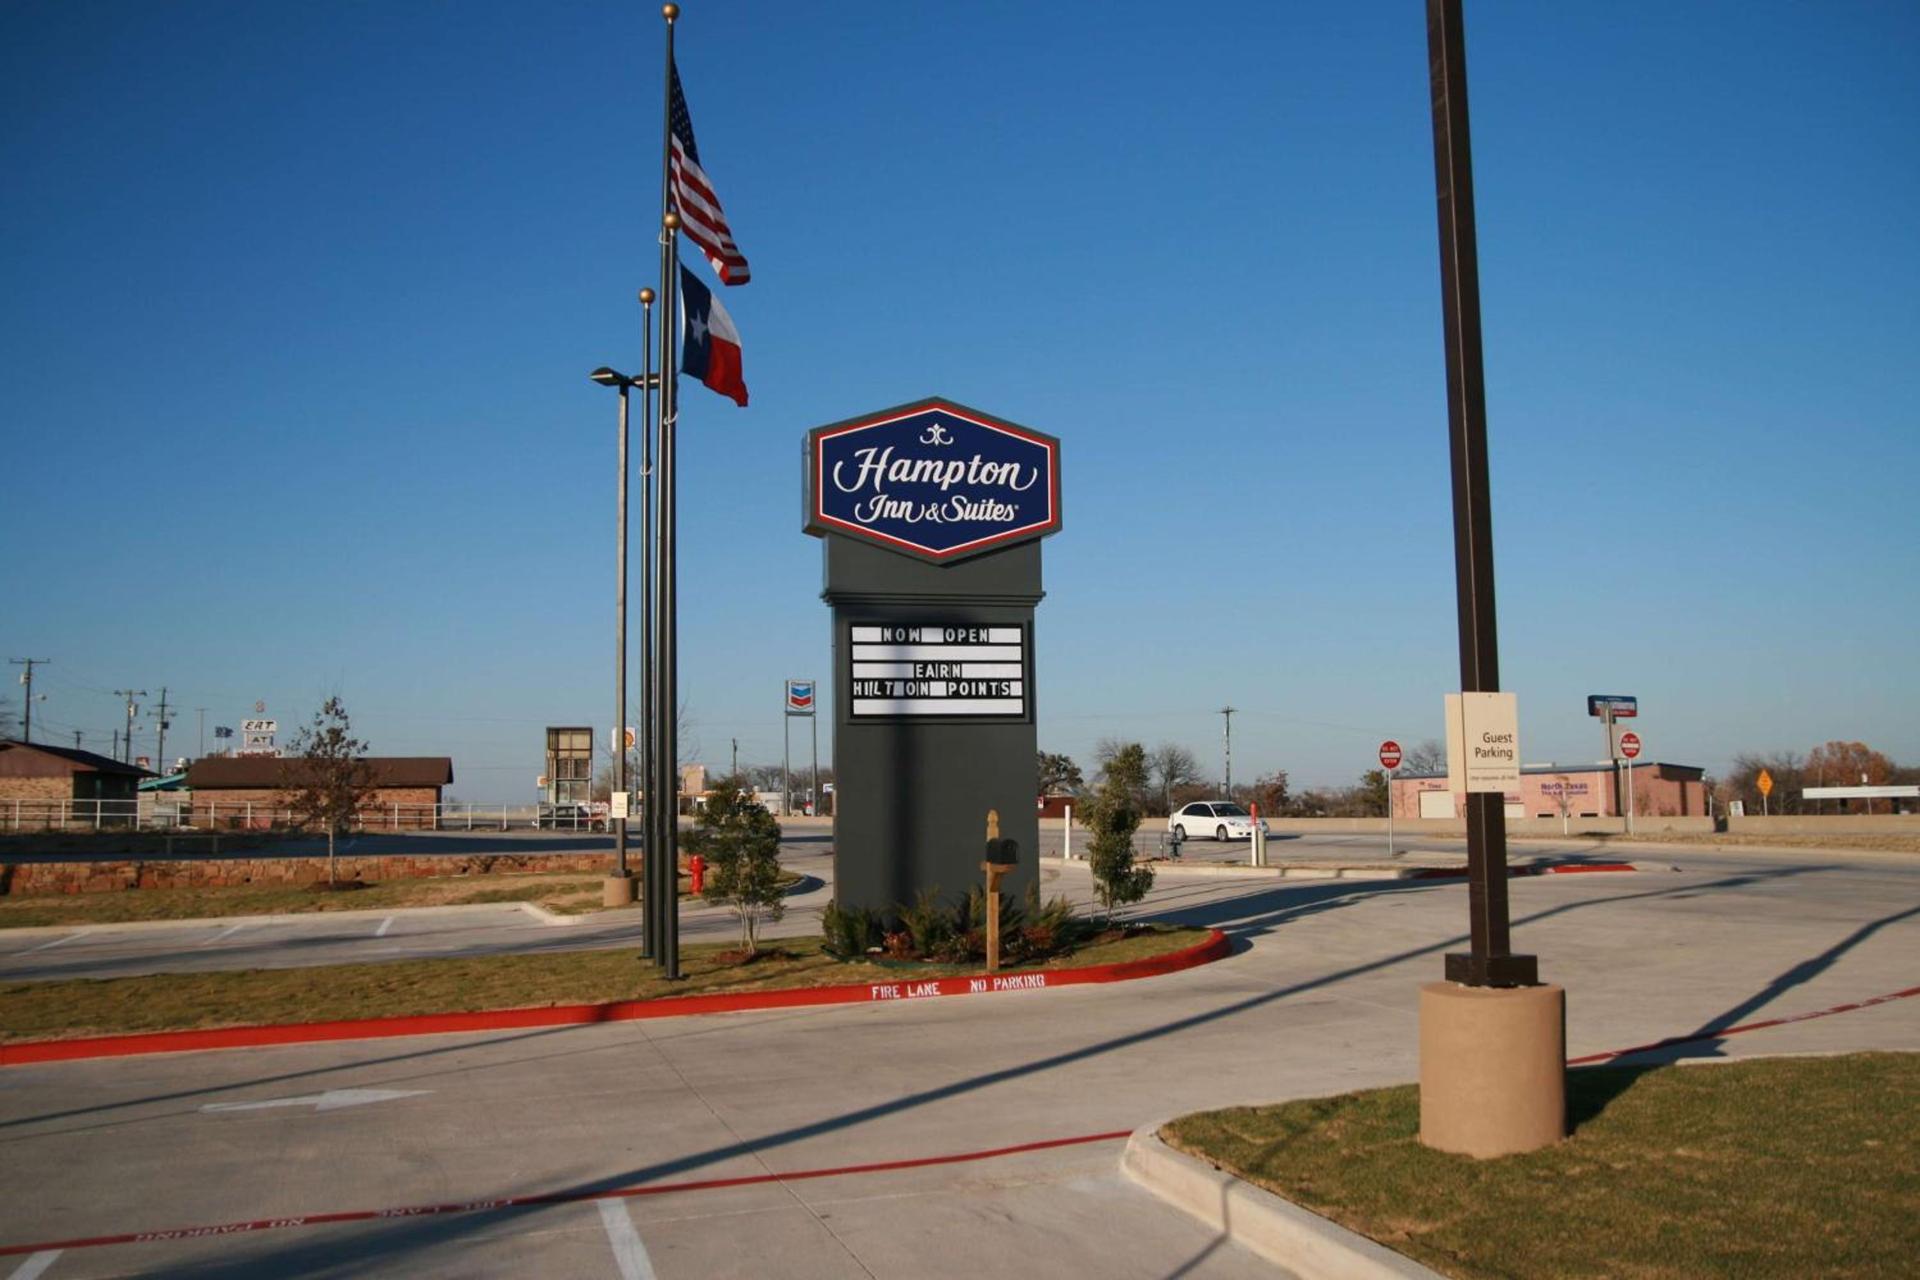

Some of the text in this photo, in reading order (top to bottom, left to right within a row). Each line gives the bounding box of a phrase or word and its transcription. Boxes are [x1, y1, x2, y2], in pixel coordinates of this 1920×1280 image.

[833, 446, 1038, 493] Hampton
[855, 495, 925, 523] Inn
[941, 495, 1016, 523] Suites
[883, 628, 989, 643] NOW OPEN
[915, 663, 961, 678] EARN
[948, 682, 1010, 697] POINTS
[245, 721, 274, 731] EAT
[1483, 732, 1513, 744] Guest
[1475, 747, 1513, 761] Parking
[871, 982, 941, 1000] FIRE LANE
[969, 974, 1046, 993] NO PARKING
